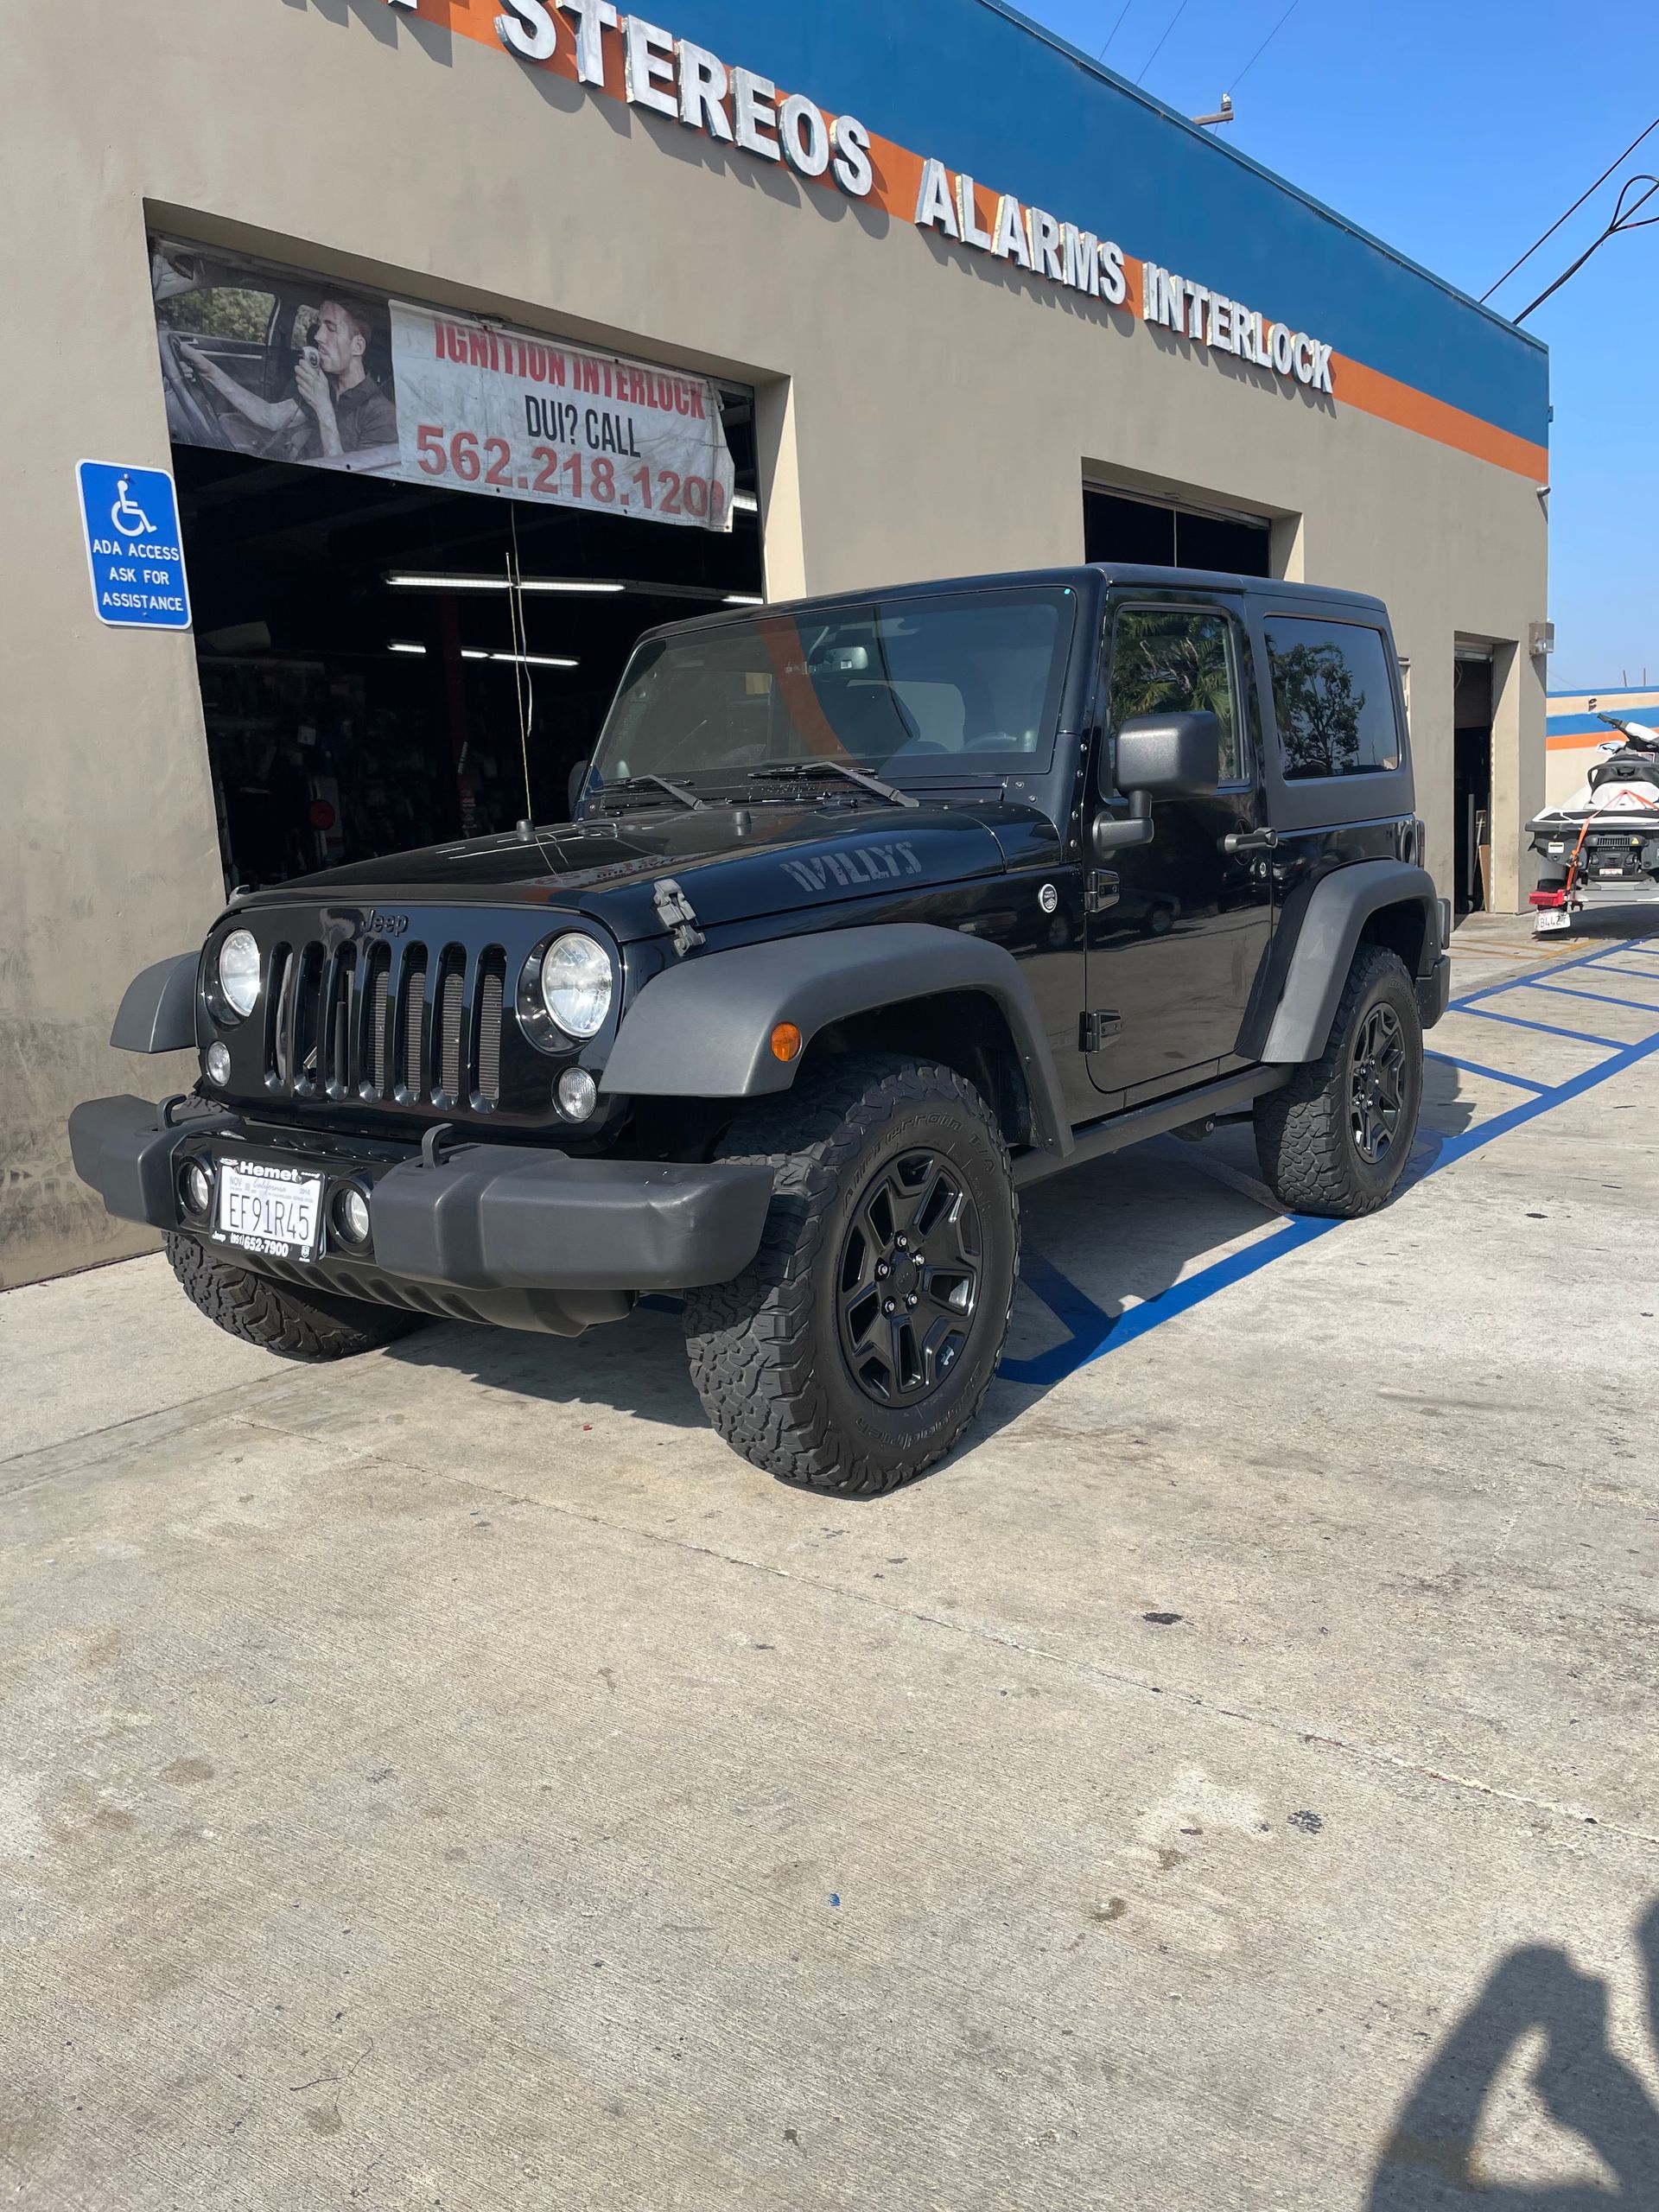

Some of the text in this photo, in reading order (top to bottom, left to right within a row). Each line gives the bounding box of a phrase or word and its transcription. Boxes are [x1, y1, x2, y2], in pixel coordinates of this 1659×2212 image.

[493, 0, 1332, 394] STEREOS ALARMS INTERLOCK
[434, 319, 706, 420] IGNITION INTERLOCK
[524, 395, 641, 458] DUI? CALL
[92, 539, 180, 562] ADA ACCESS
[109, 567, 169, 586] ASK FOR
[102, 592, 184, 612] ASSISTANCE
[779, 842, 923, 892] WILLYS
[359, 909, 409, 938] Jeep
[239, 1160, 299, 1183] Hemet
[230, 1192, 309, 1240] EF91R45
